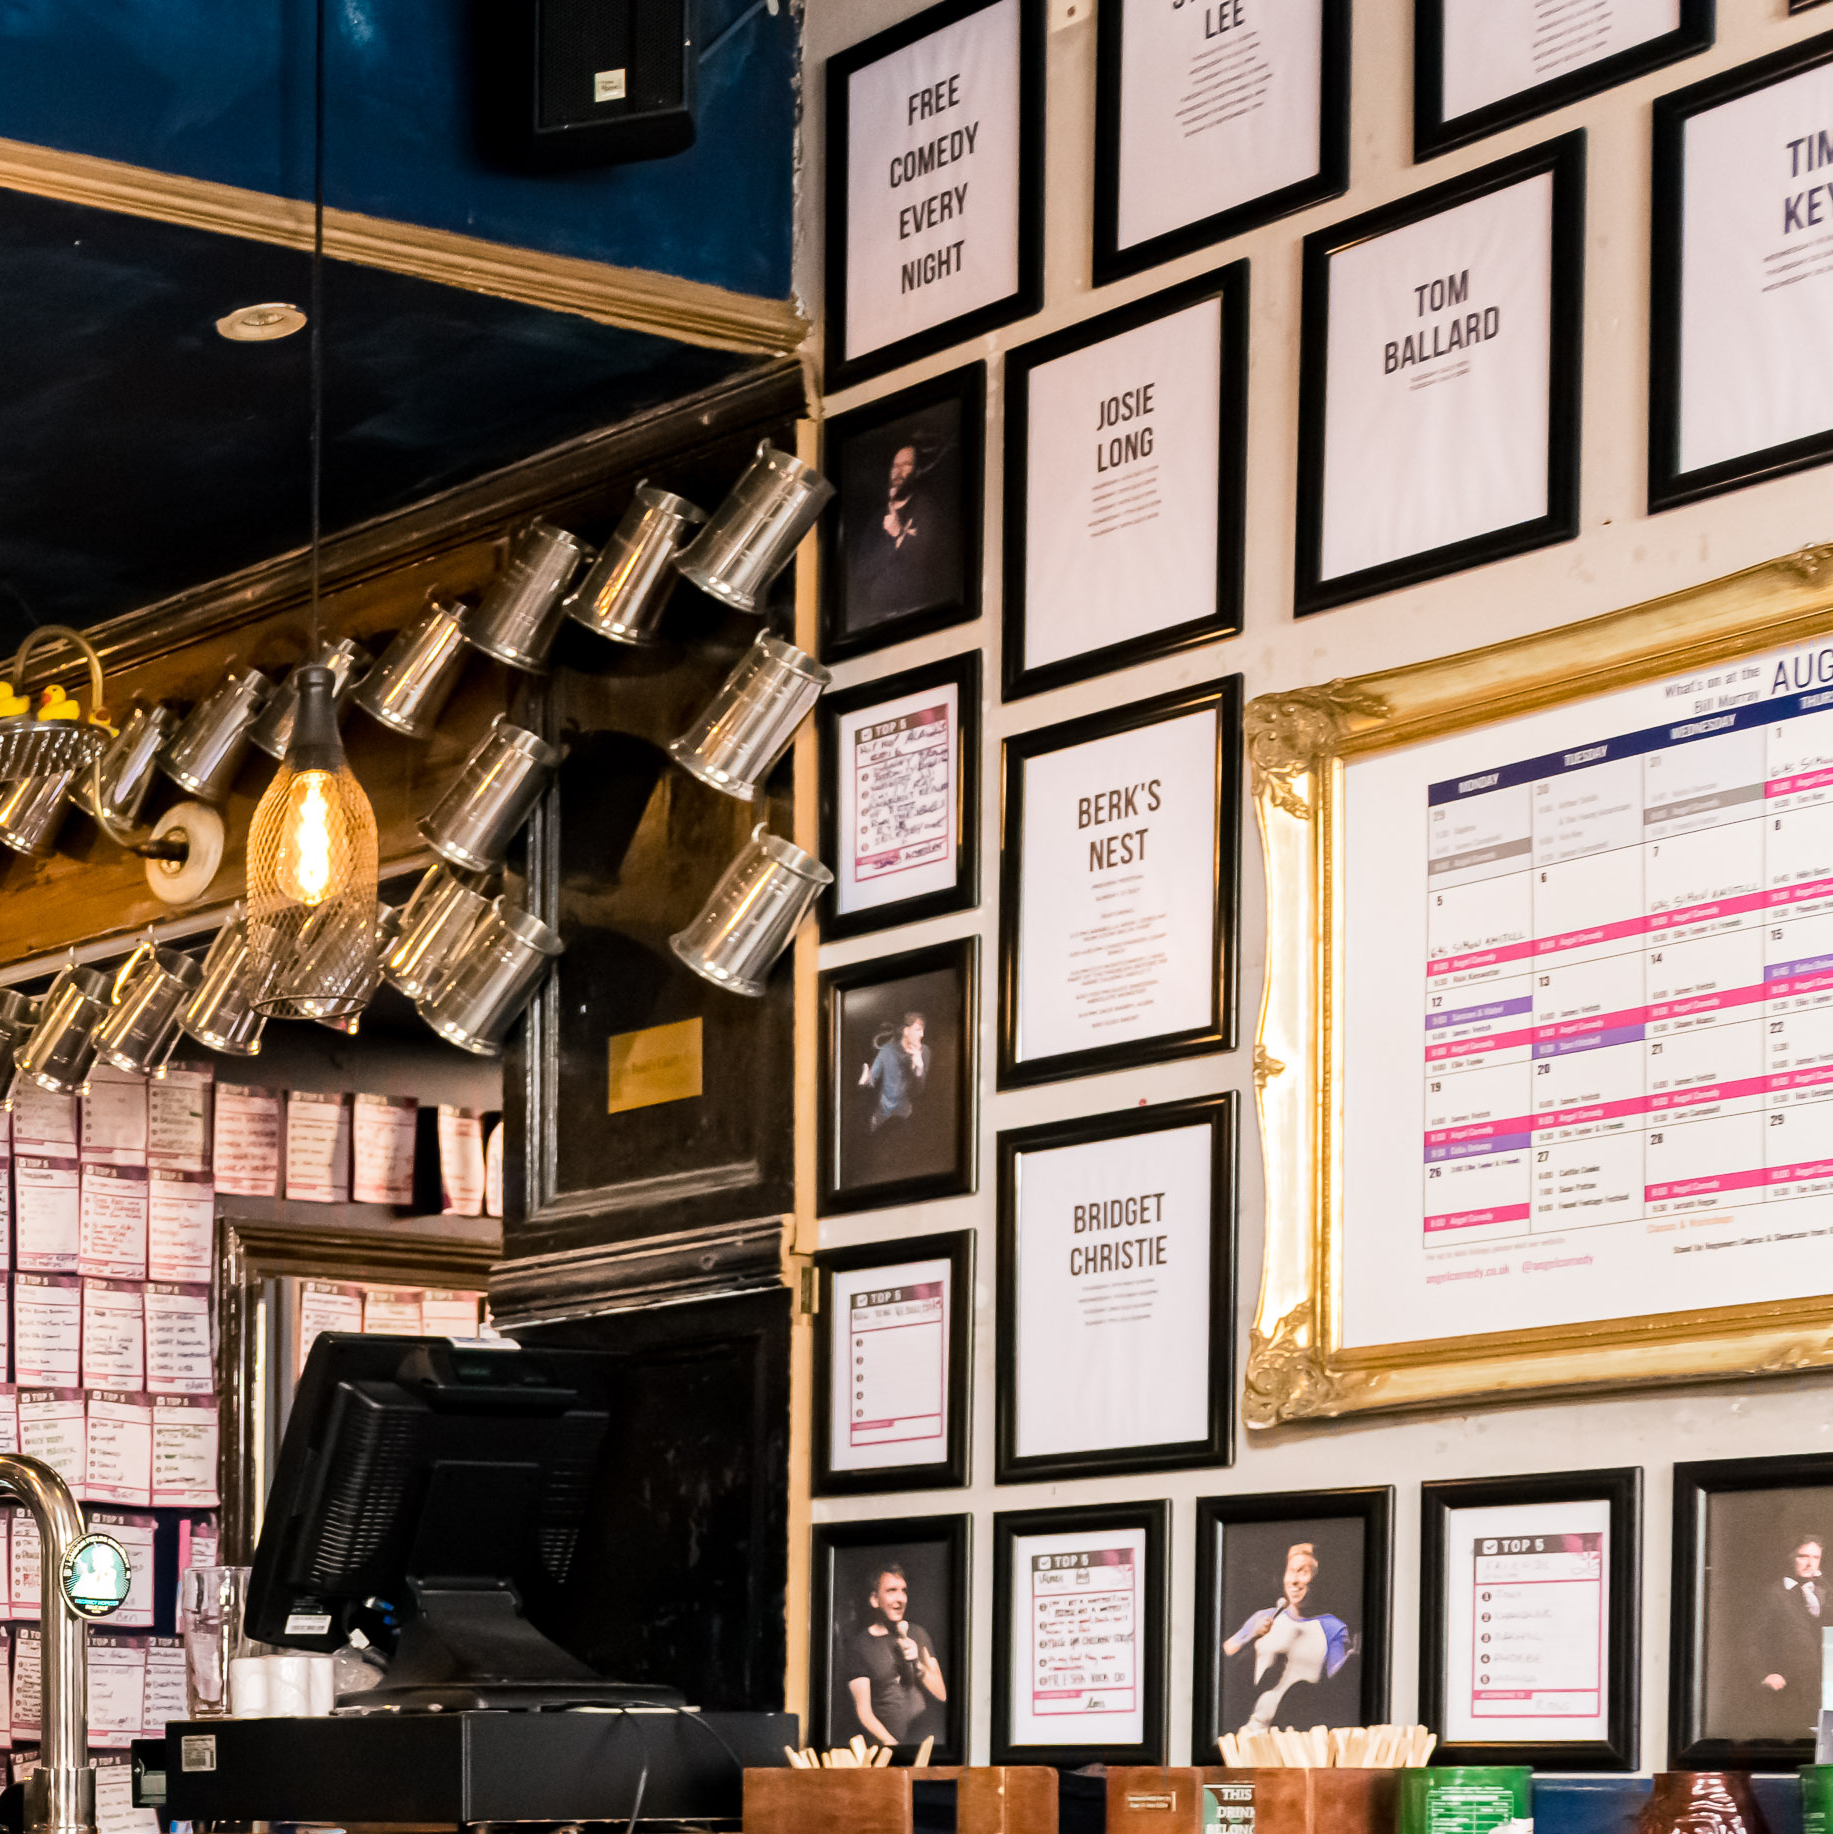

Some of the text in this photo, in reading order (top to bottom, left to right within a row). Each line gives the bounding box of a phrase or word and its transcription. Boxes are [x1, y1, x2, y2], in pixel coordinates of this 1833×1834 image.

[1204, 2, 1246, 39] LEE
[907, 73, 961, 126] FREE
[890, 121, 980, 188] COMEDY
[899, 182, 968, 240] EVERY
[901, 239, 965, 294] NIGHT
[1414, 269, 1469, 318] TOM
[1384, 306, 1501, 375] BALLARD
[1097, 383, 1155, 431] JOSIE
[1096, 427, 1154, 472] LONG
[1664, 665, 1760, 699] What's on at the
[1695, 688, 1760, 714] Bill Murray
[1077, 779, 1162, 831] BERK'S
[1088, 828, 1148, 872] NEST
[1437, 896, 1443, 907] 5
[1770, 928, 1783, 941] 15
[1651, 953, 1663, 964] 14
[1539, 976, 1549, 987] 13
[1770, 1021, 1784, 1034] 22
[1073, 1192, 1165, 1234] BRIDGET
[1069, 1234, 1168, 1277] CHRISTIE
[870, 1289, 902, 1305] TOP 5
[1055, 1555, 1089, 1568] TOP 5
[1502, 1539, 1544, 1552] TOP 5
[1221, 1788, 1252, 1800] THIS
